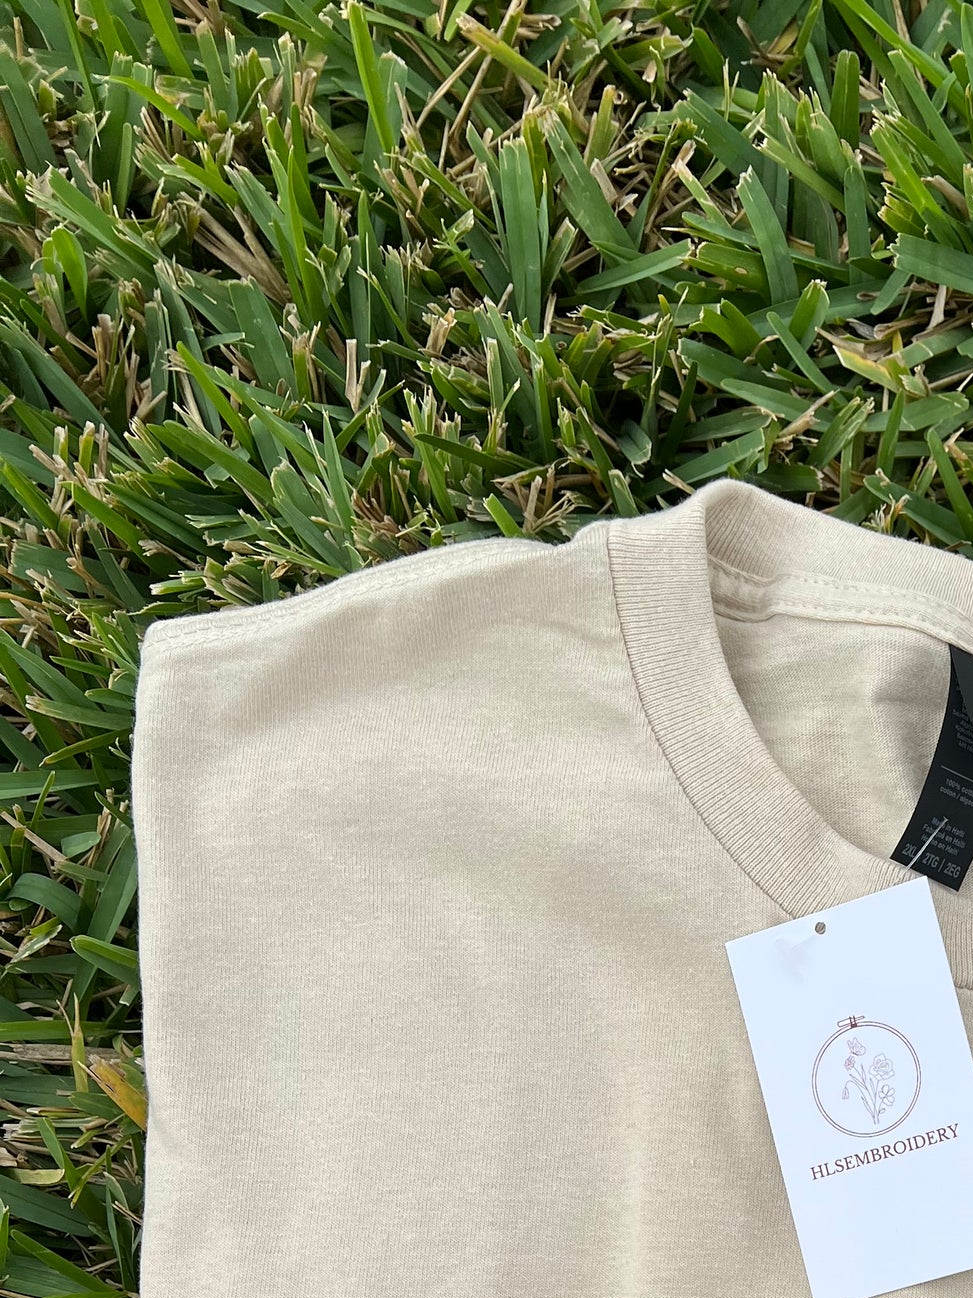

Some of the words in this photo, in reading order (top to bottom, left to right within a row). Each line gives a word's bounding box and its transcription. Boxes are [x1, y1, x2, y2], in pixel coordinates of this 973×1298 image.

[940, 786, 957, 798] coton
[902, 843, 917, 858] 2XL
[922, 852, 940, 868] 2TG
[944, 862, 961, 878] 2EG
[810, 1123, 959, 1181] HLSEMBROIDERY
